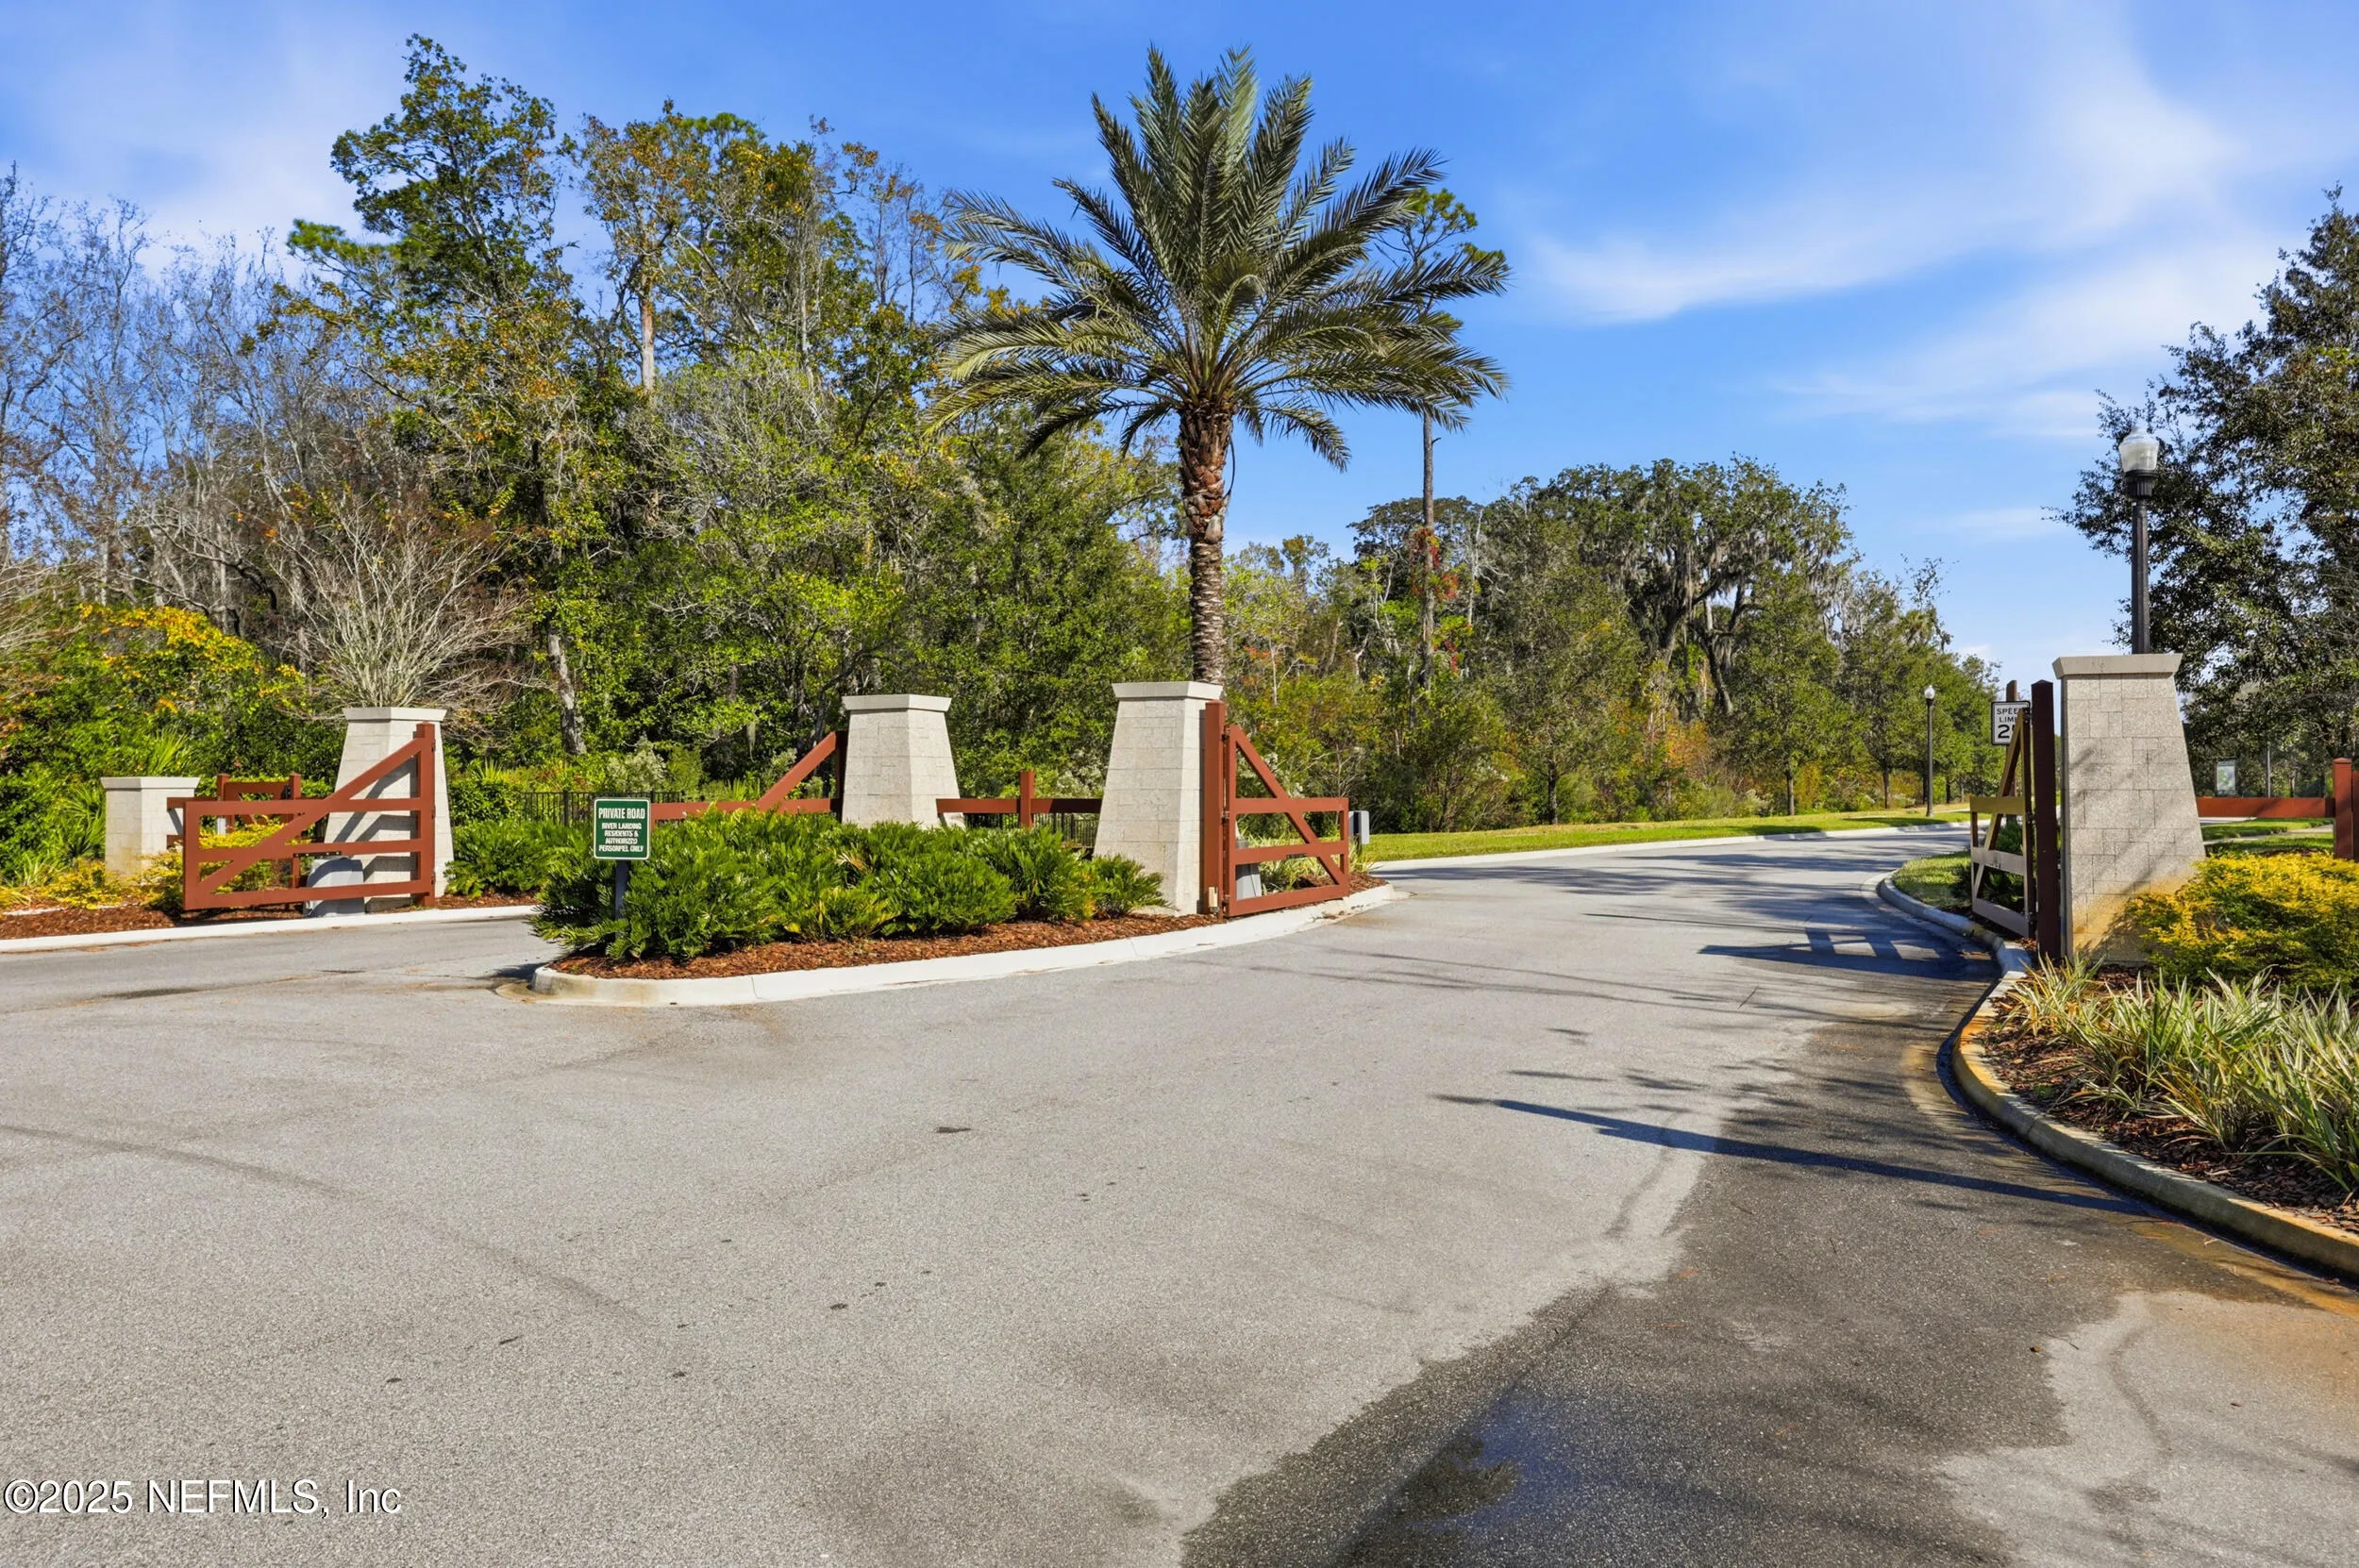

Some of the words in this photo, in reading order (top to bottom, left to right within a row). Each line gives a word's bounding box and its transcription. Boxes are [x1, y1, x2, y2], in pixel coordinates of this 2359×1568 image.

[1998, 724, 2015, 739] 2
[598, 808, 626, 819] PRIVATE
[627, 808, 645, 819] ROAD
